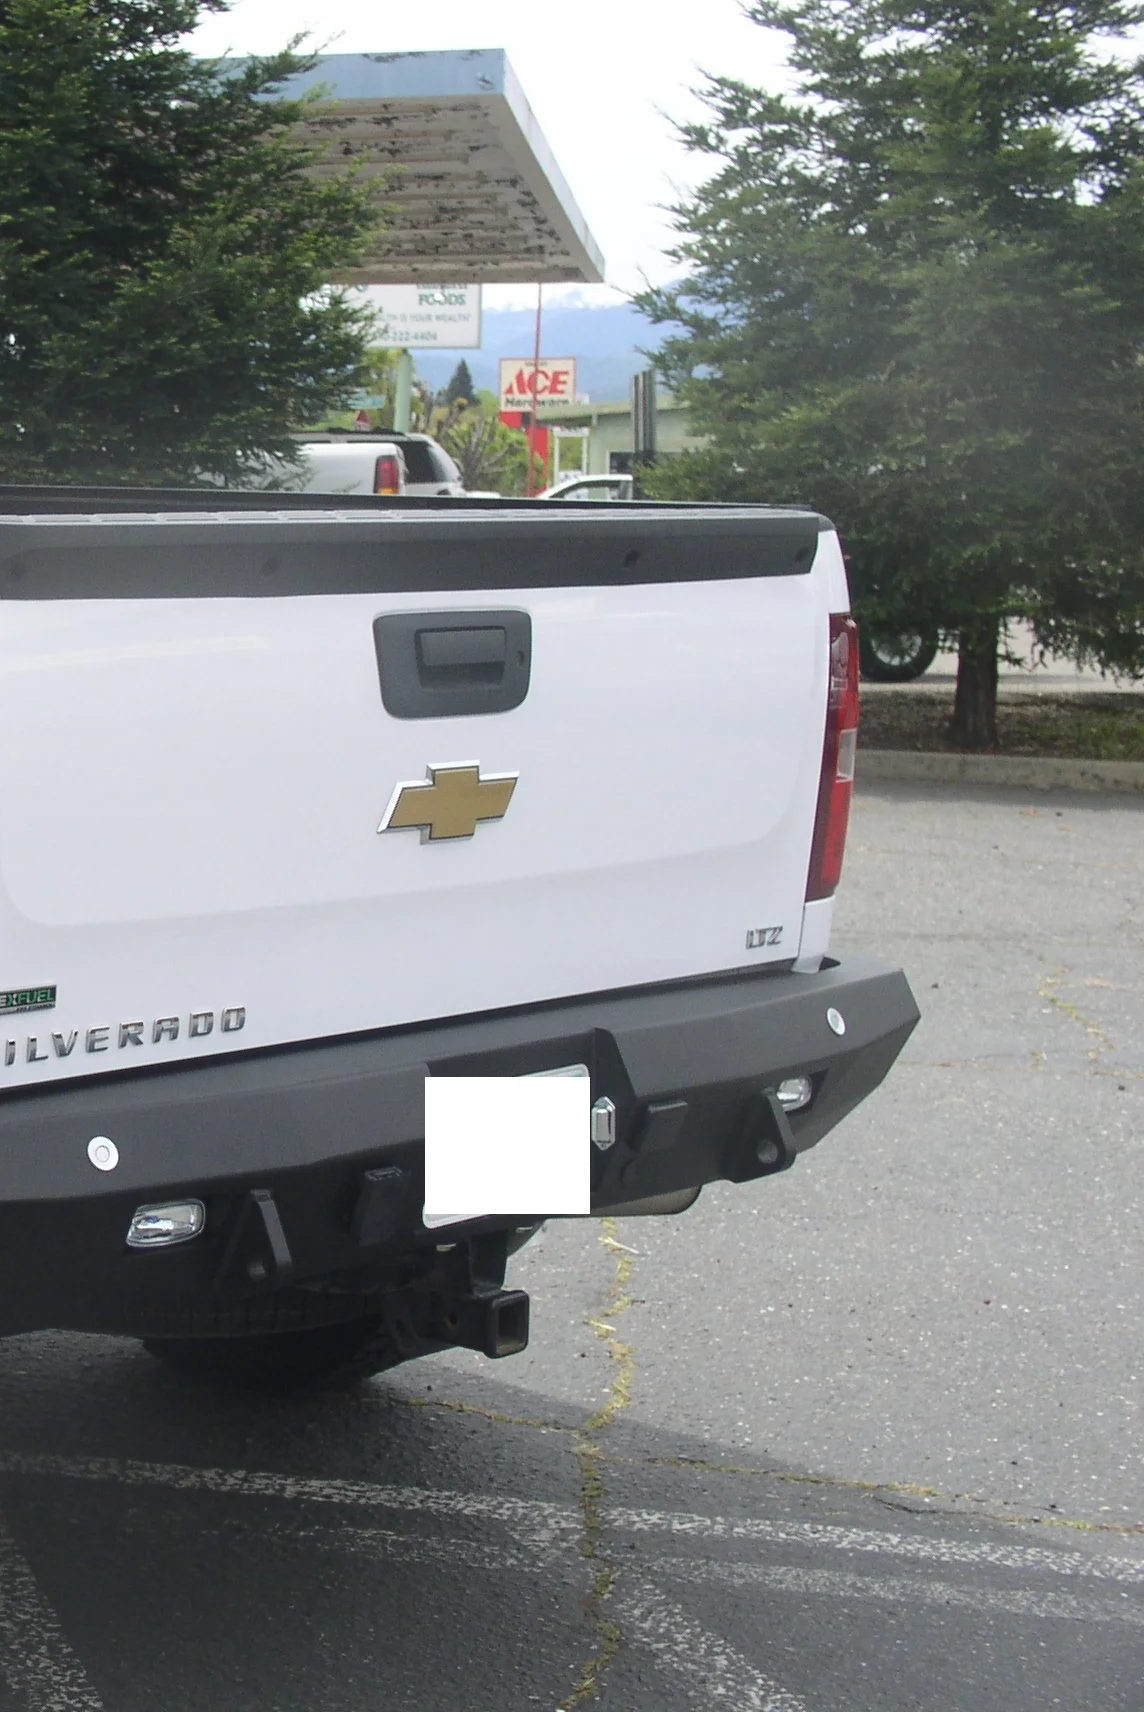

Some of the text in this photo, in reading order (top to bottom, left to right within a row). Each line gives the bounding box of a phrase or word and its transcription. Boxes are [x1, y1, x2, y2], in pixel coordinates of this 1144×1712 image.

[418, 293, 467, 306] FOODS
[505, 369, 570, 395] ACE
[745, 925, 784, 950] LTZ
